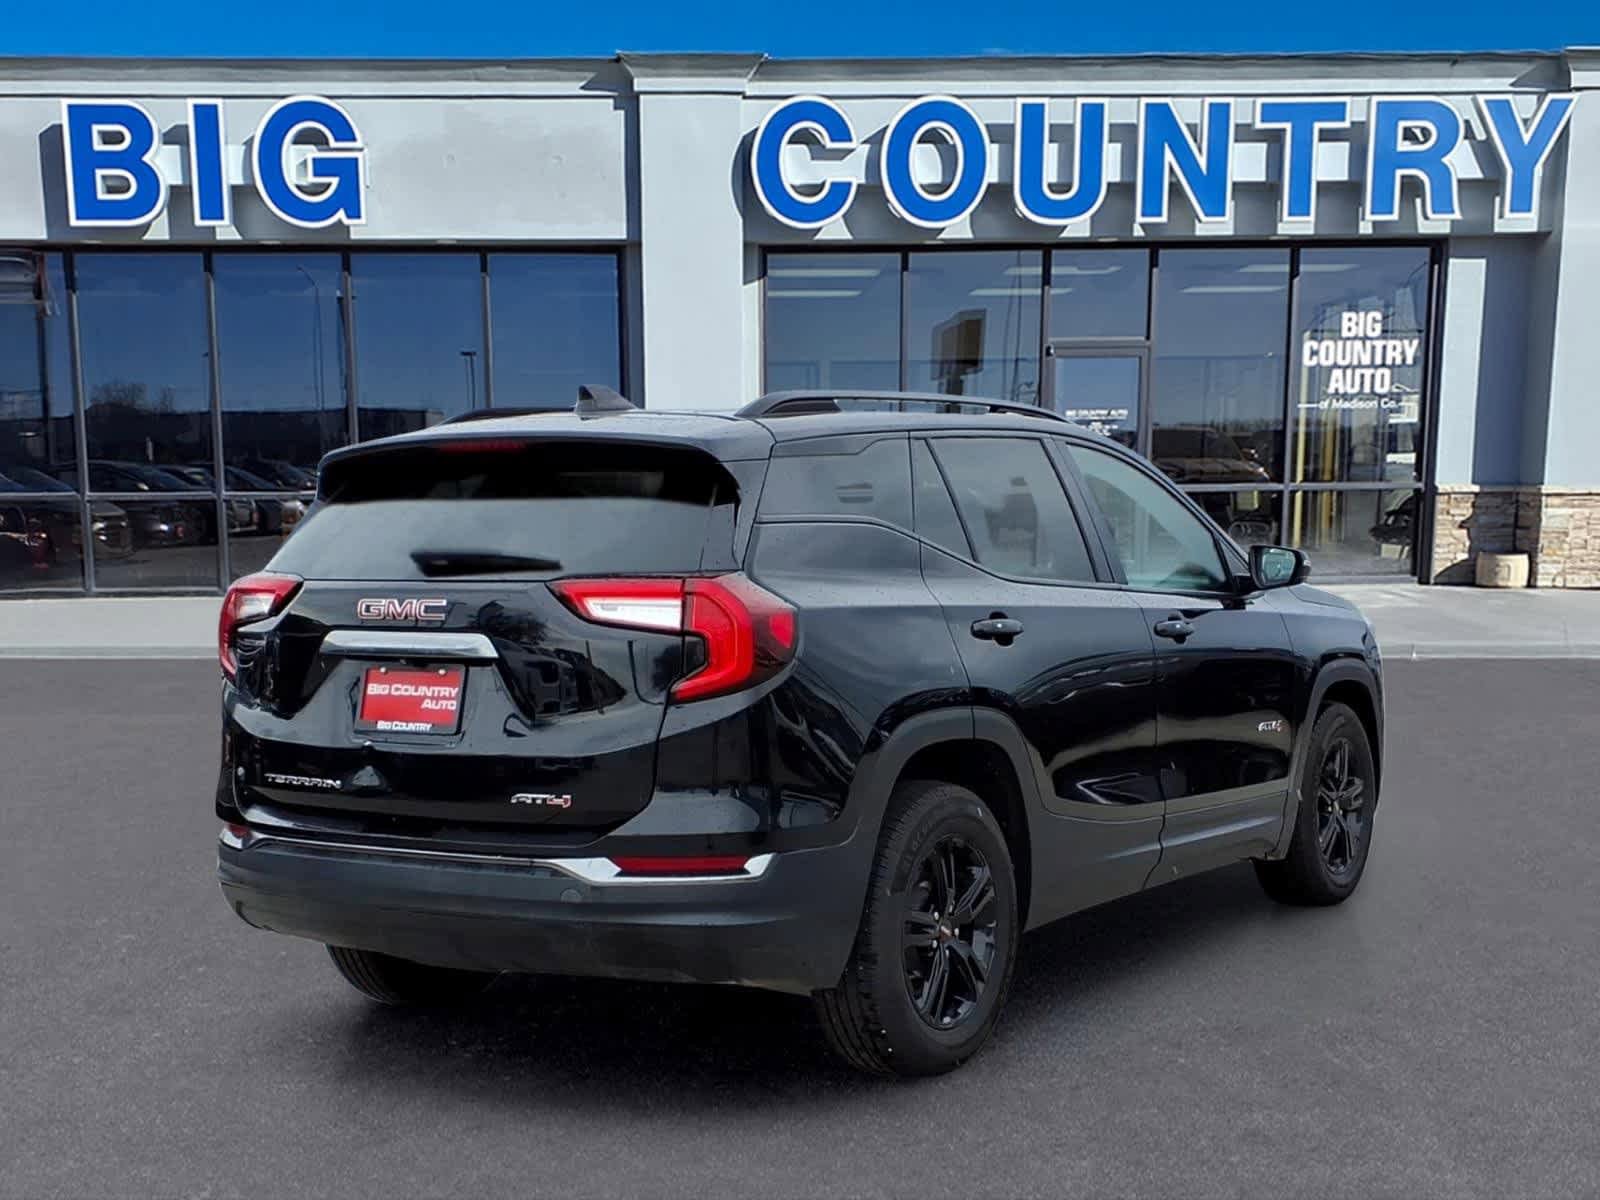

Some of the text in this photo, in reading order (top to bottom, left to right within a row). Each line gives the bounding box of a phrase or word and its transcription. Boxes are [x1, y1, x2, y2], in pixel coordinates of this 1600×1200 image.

[61, 94, 1574, 229] BIG COUNTRY
[1341, 311, 1382, 338] BIG
[1303, 339, 1419, 367] COUNTRY
[1327, 368, 1391, 394] AUTO
[357, 598, 447, 621] GMC
[366, 683, 459, 698] BIG COUNTRY
[421, 699, 457, 710] AUTO
[377, 720, 432, 732] BIG COUNTRY
[264, 773, 341, 789] TERRAIN
[511, 793, 571, 808] AT4
